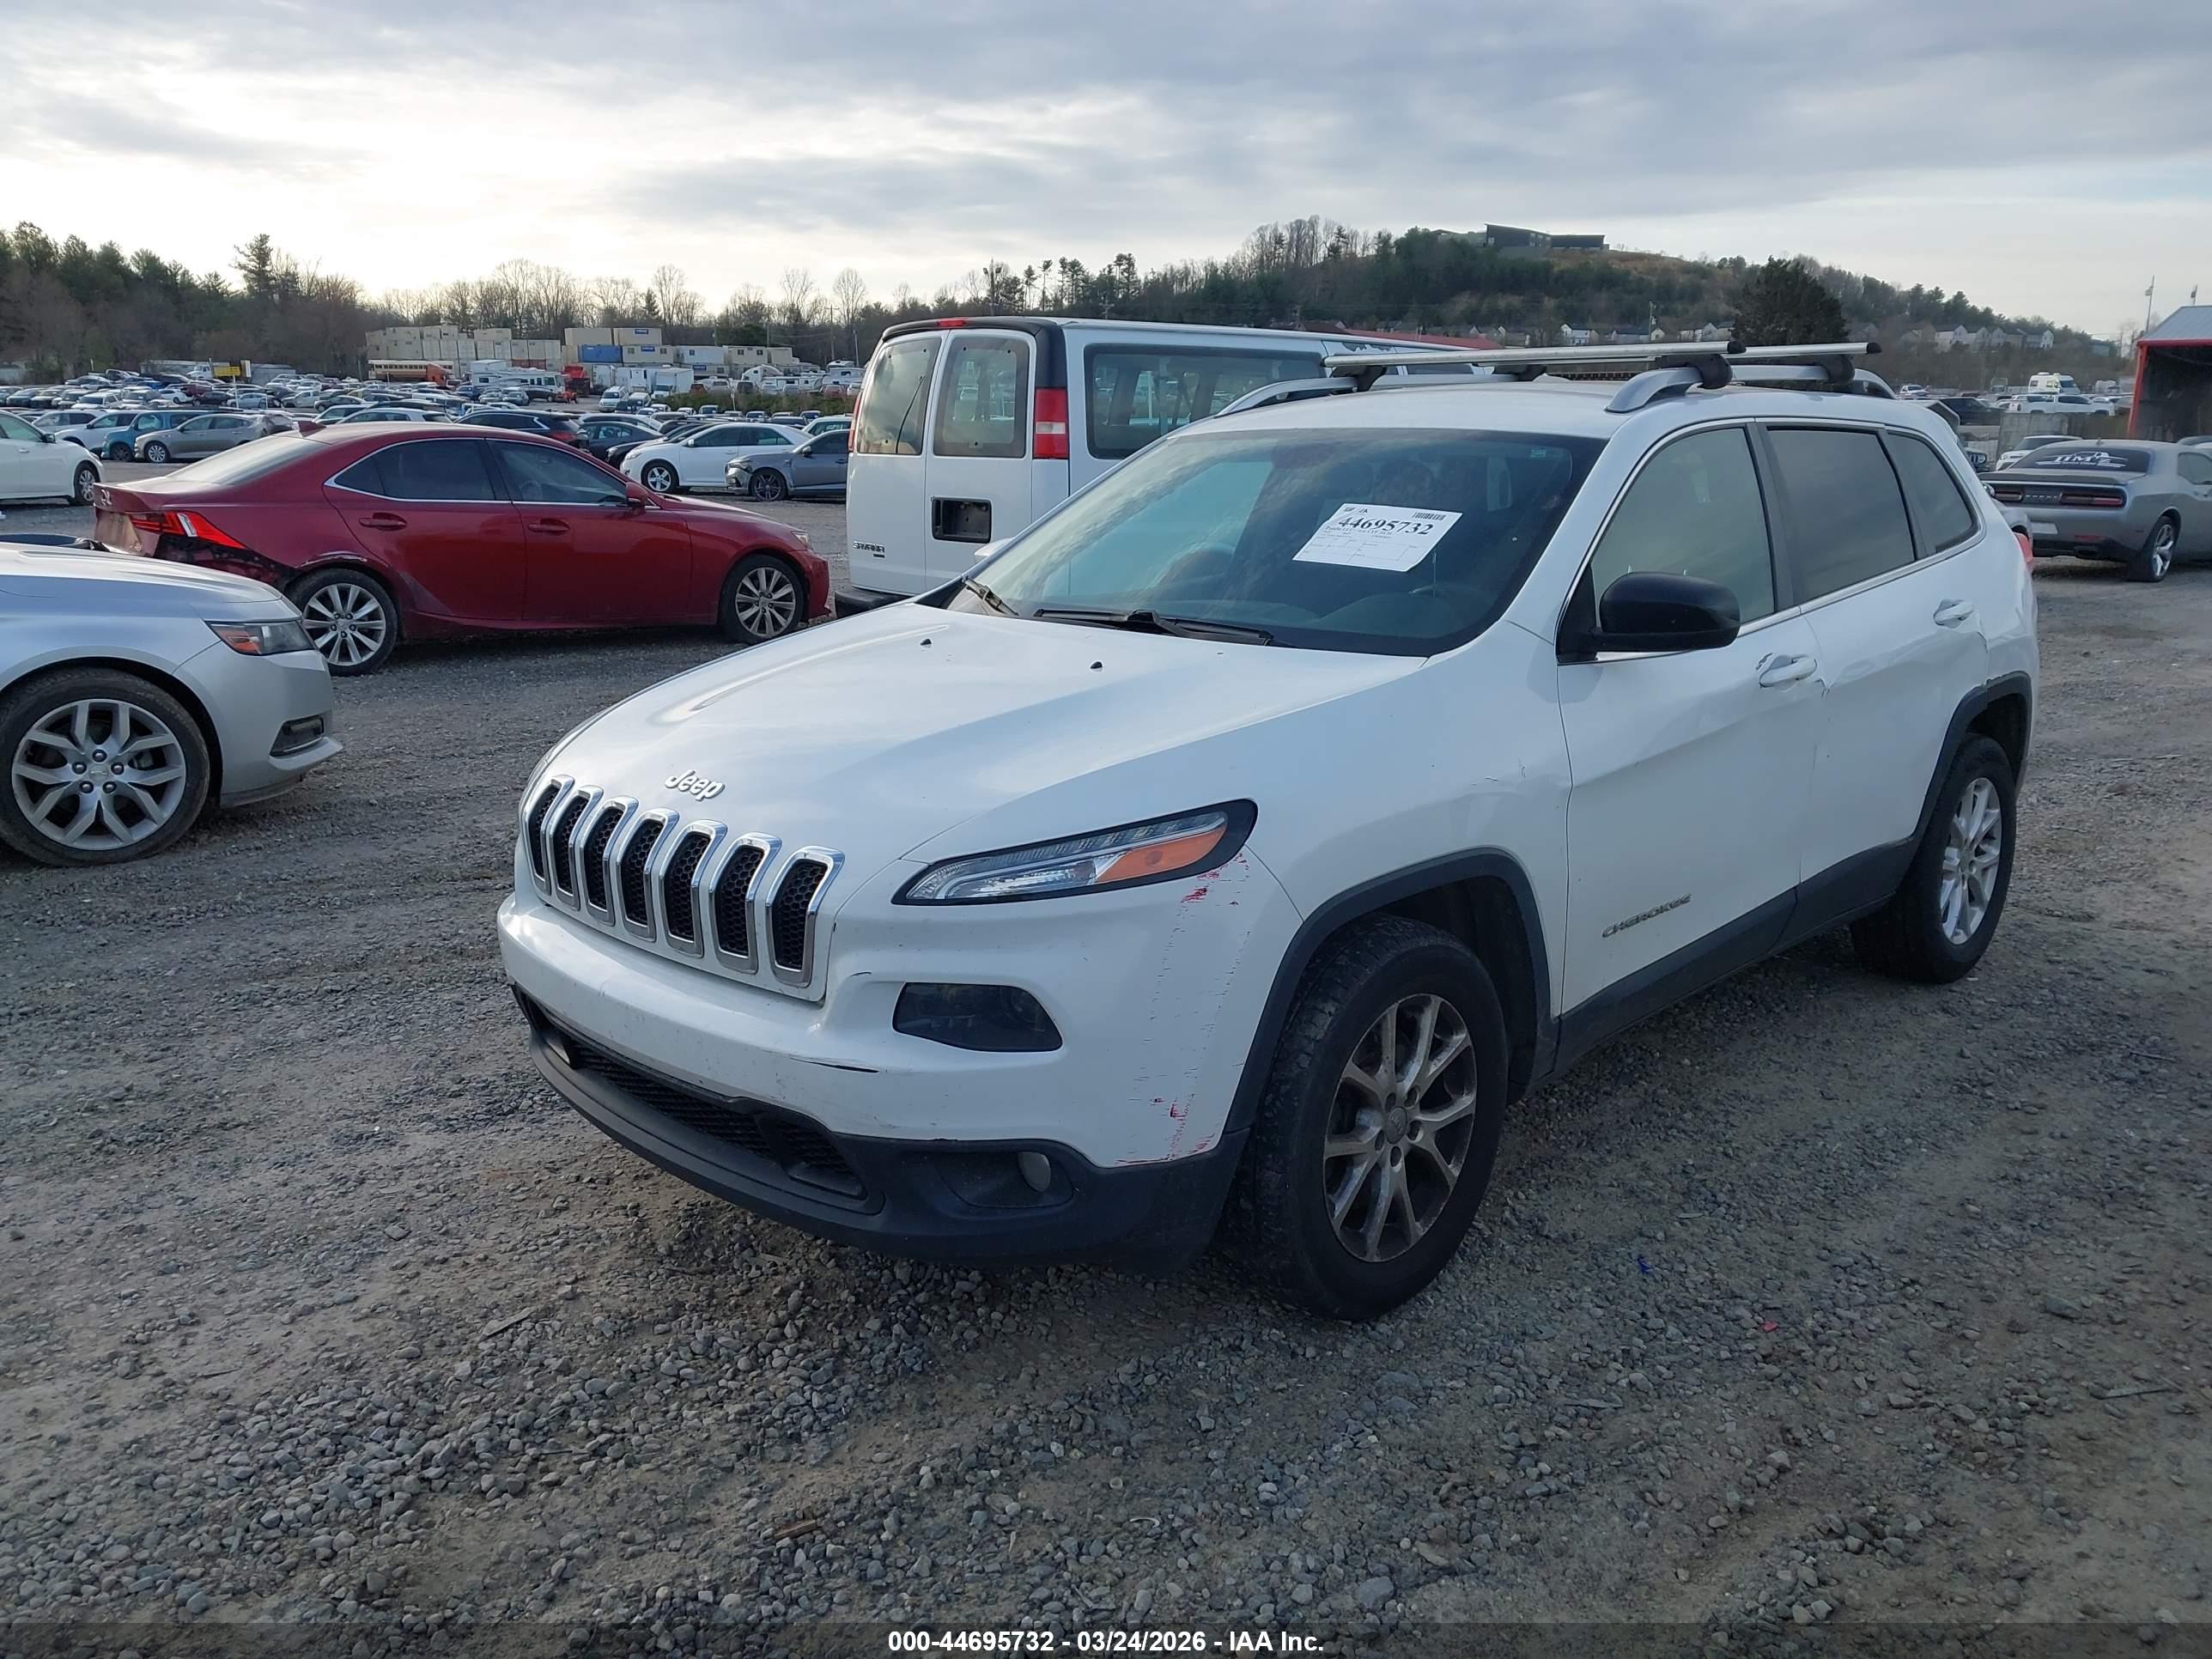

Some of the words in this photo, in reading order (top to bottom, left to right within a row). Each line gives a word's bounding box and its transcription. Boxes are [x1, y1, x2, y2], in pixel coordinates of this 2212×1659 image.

[1338, 516, 1434, 535] 44695732
[665, 769, 725, 802] Jeep
[1601, 892, 1692, 938] CHEROKEE
